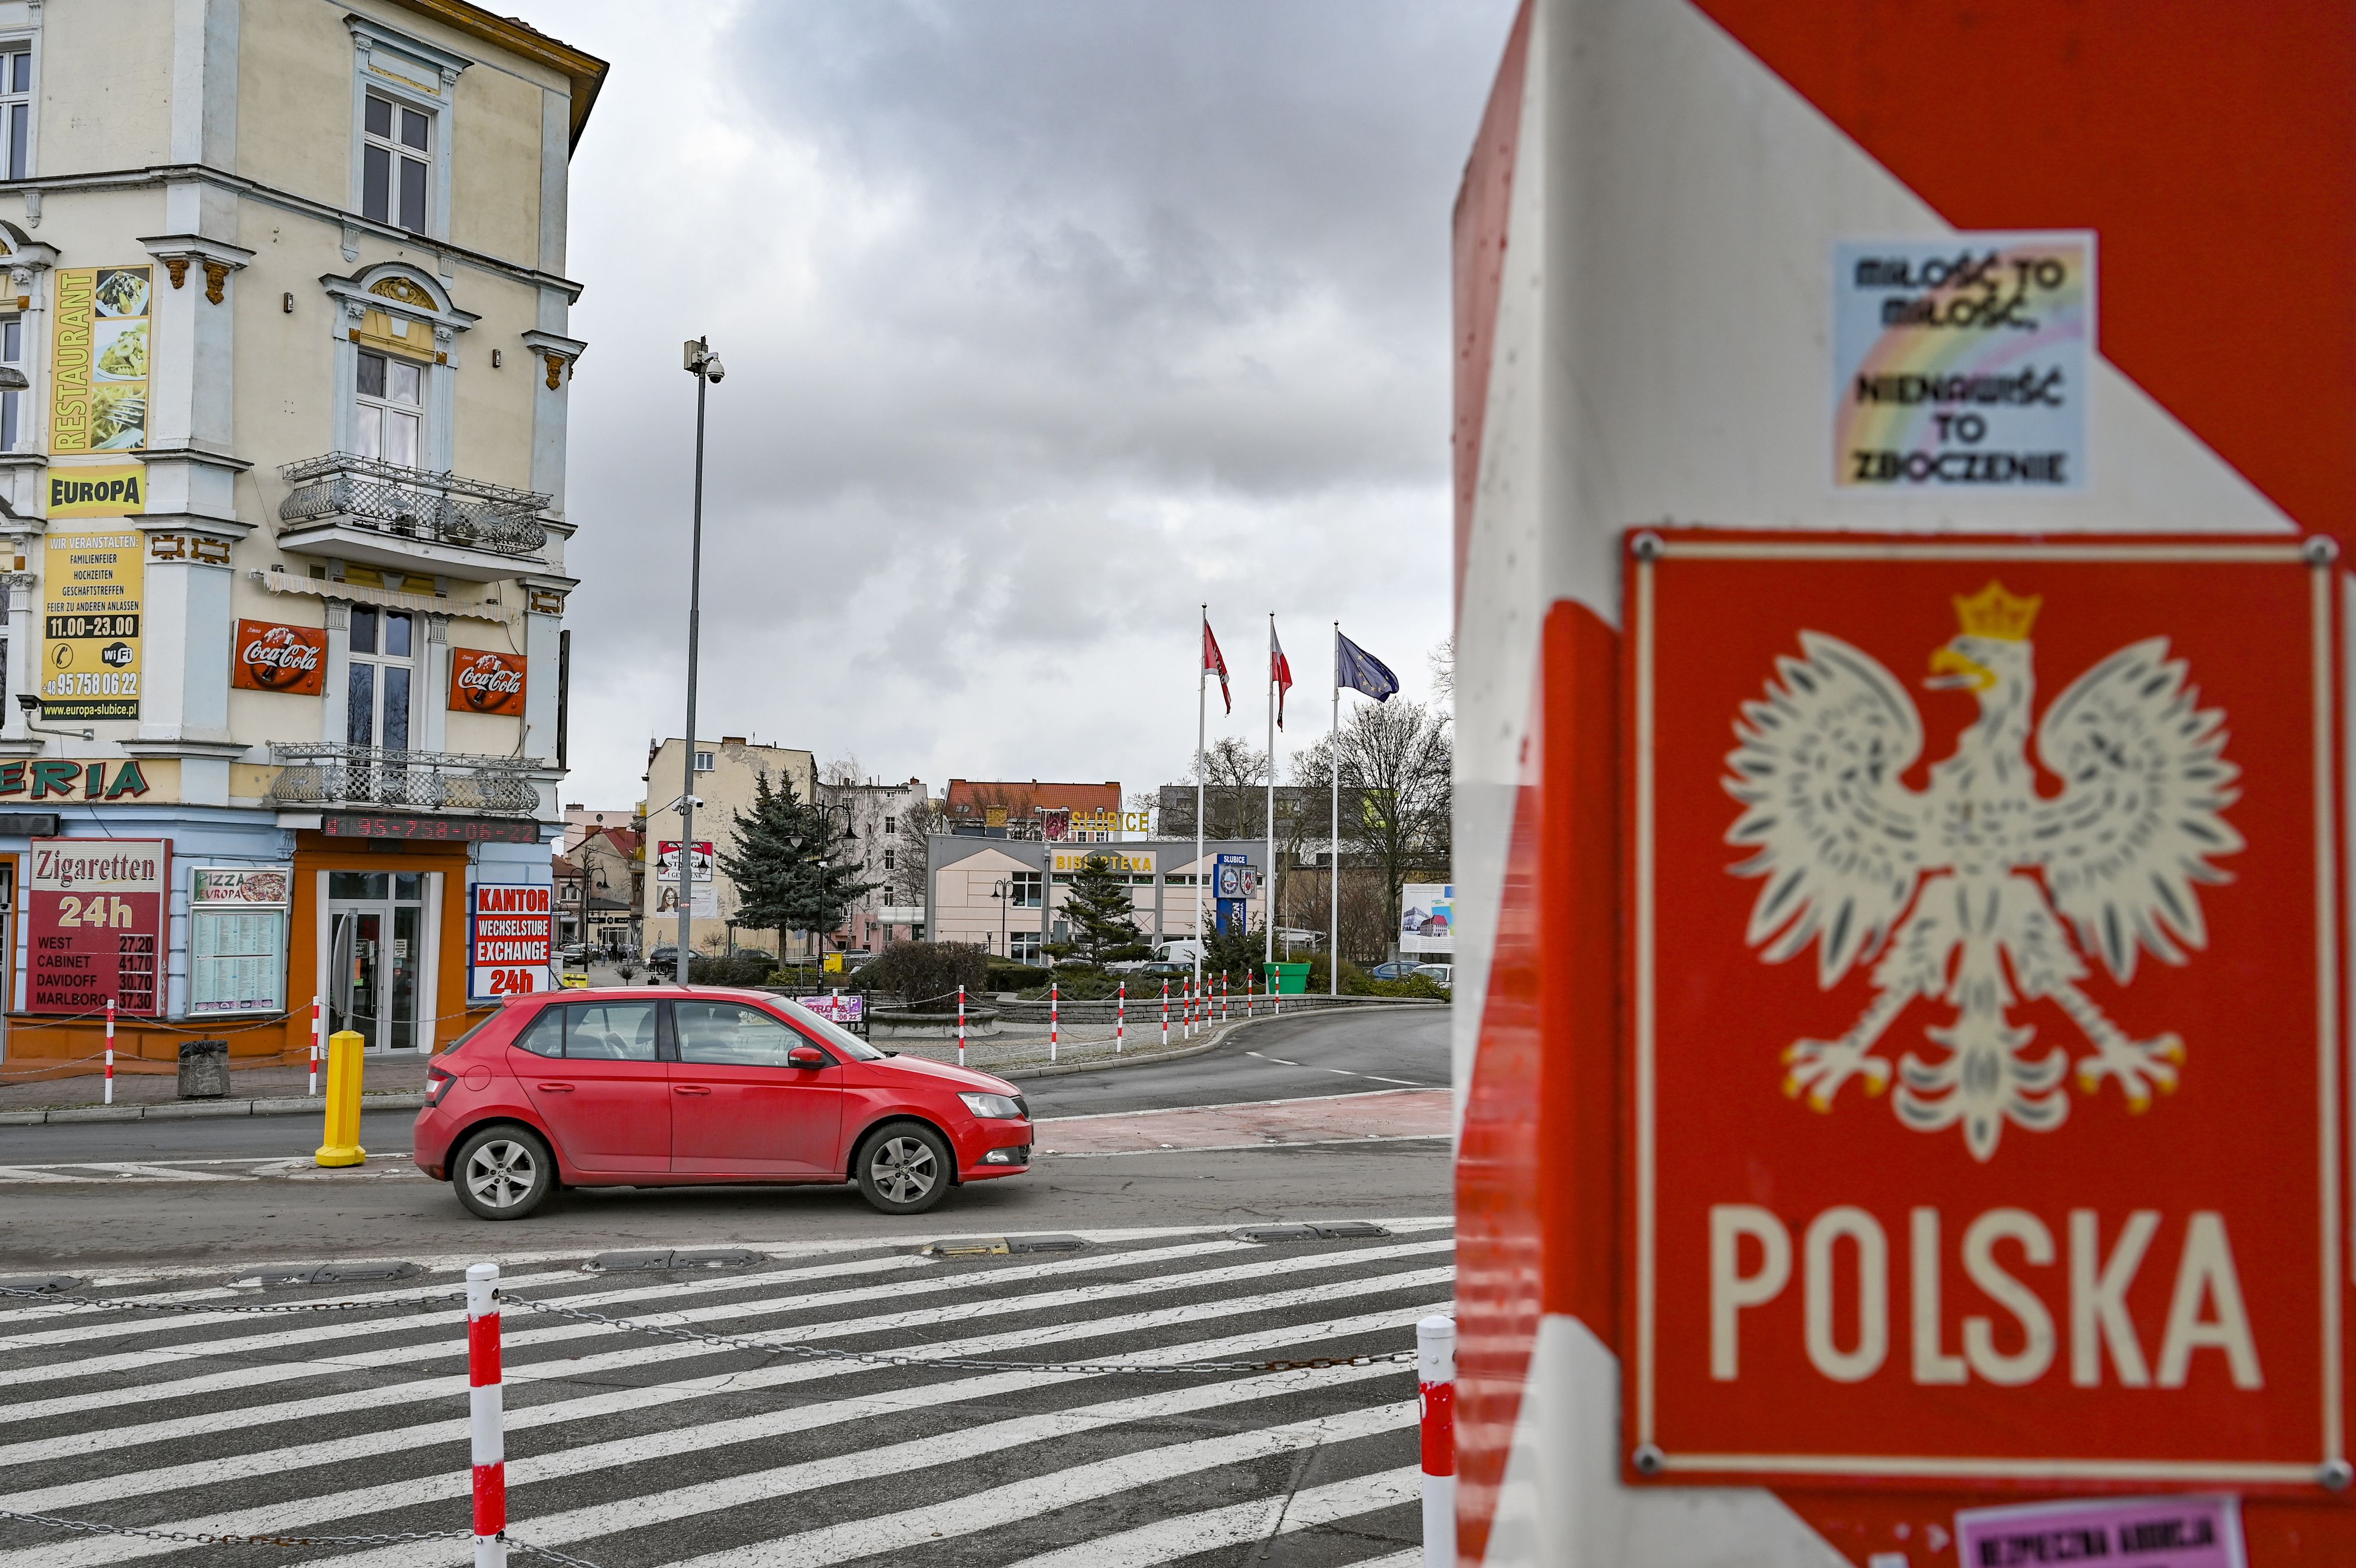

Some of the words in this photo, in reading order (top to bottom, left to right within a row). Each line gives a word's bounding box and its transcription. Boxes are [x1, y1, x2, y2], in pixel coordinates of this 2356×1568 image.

[1855, 250, 2000, 289] MIŁOŚĆ
[2013, 257, 2066, 290] TO
[55, 273, 92, 450] RESTAURANT
[1855, 365, 2067, 406] NIENAWIŚĆ
[1933, 413, 1987, 445] TO
[1851, 449, 2069, 485] ZBOCZENIE
[51, 477, 140, 507] EUROPA
[50, 537, 67, 550] WIR
[69, 536, 139, 549] VERANSTALTEN:
[70, 554, 117, 564] FAMILIENFEIER
[74, 570, 113, 580] HOCHZEITEN
[62, 584, 124, 596] GESCHÄFTSTREFFEN
[47, 603, 64, 612] FEIER
[67, 602, 74, 612] ZU
[76, 601, 105, 611] ANDEREN
[107, 599, 139, 611] ANLÄSSEN
[243, 640, 320, 670] Coca-Cola
[42, 680, 57, 696] +48
[58, 673, 74, 696] 95
[76, 673, 101, 696] 758
[102, 672, 119, 695] 06
[121, 672, 137, 695] 22
[458, 666, 524, 693] Coca-Cola
[44, 703, 137, 717] www.europa-slubice.pl
[0, 760, 150, 800] ERIA
[1071, 811, 1149, 832] SŁUBICE
[36, 850, 154, 888] Zigaretten
[1223, 855, 1245, 864] SŁUBICE
[198, 873, 244, 887] PIZZA
[479, 888, 549, 912] KANTOR
[58, 896, 133, 929] 24h
[478, 919, 548, 937] WECHSELSTUBE
[38, 937, 72, 950] WEST
[120, 937, 154, 953] 27.20
[477, 941, 548, 961] EXCHANGE
[37, 955, 91, 968] CABINET
[119, 955, 153, 972] 41.70
[37, 974, 97, 987] DAVIDOFF
[119, 974, 152, 991] 30.70
[490, 968, 534, 994] 24h
[37, 992, 108, 1006] MARLBORO
[119, 993, 152, 1010] 37.30
[850, 998, 858, 1007] P
[1709, 1203, 2264, 1391] POLSKA
